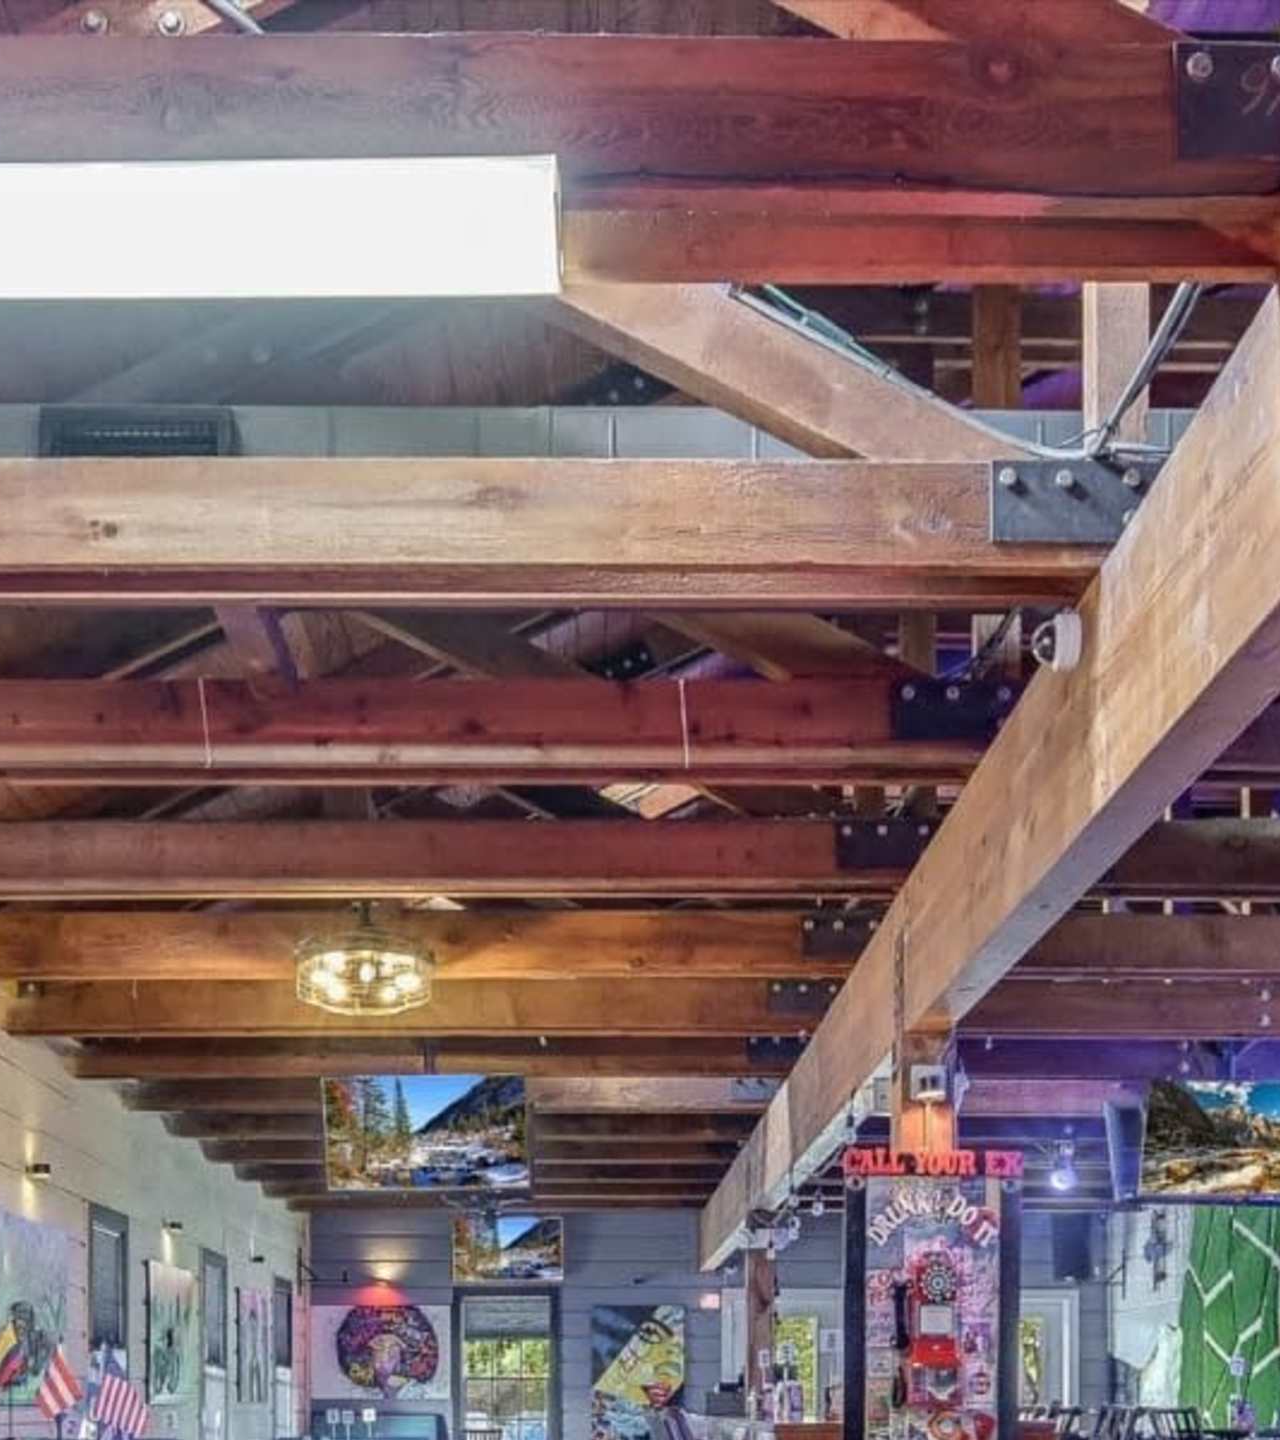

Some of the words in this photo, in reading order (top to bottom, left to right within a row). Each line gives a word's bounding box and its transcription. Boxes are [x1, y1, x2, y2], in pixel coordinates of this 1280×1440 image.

[843, 1148, 905, 1175] CALL
[914, 1149, 977, 1176] YOUR
[946, 1194, 978, 1226] DO
